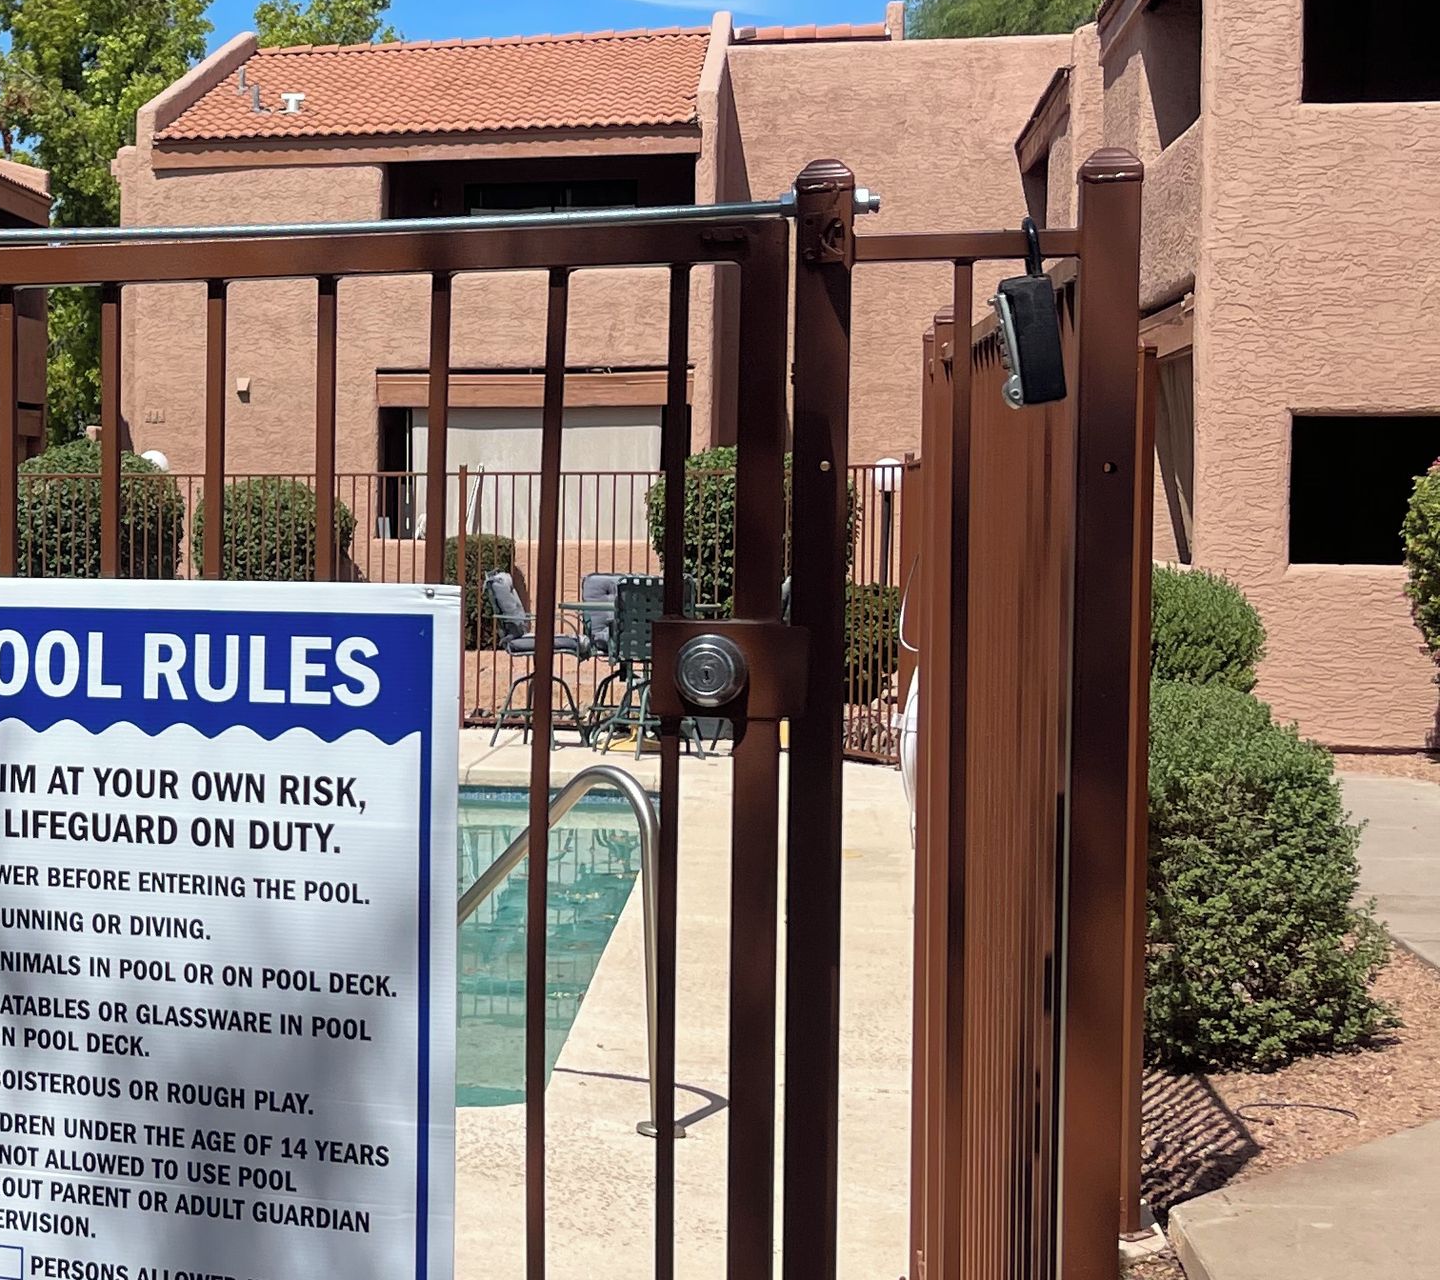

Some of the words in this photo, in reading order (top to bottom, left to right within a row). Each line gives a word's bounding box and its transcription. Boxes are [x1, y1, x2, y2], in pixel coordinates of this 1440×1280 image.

[144, 633, 380, 706] RULES
[47, 766, 84, 795] AT
[93, 768, 178, 799] YOUR
[192, 771, 265, 803] OWN
[280, 775, 365, 814] RISK,
[5, 809, 177, 844] LIFEGUARD
[191, 817, 234, 848] ON
[250, 820, 340, 853] DUTY.
[48, 867, 130, 891] BEFORE
[139, 872, 245, 897] ENTERING
[253, 878, 295, 900] THE
[305, 881, 369, 904] POOL.
[92, 913, 121, 935] OR
[131, 916, 210, 940] DIVING.
[90, 957, 110, 978] IN
[120, 959, 176, 982] POOL
[184, 963, 213, 985] OR
[222, 966, 252, 987] ON
[263, 968, 321, 992] POOL
[330, 973, 396, 997] DECK.
[99, 1001, 128, 1023] OR
[136, 1004, 272, 1033] GLASSWARE
[281, 1014, 302, 1036] IN
[312, 1016, 371, 1041] POOL
[24, 1028, 78, 1051] POOL
[87, 1033, 149, 1057] DECK.
[129, 1080, 158, 1102] OR
[168, 1083, 244, 1109] ROUGH
[255, 1090, 313, 1115] PLAY.
[65, 1118, 137, 1144] UNDER
[144, 1125, 185, 1148] THE
[191, 1129, 236, 1153] AGE
[244, 1134, 272, 1155] OF
[281, 1137, 308, 1159] 14
[315, 1140, 389, 1166] YEARS
[0, 1144, 39, 1166] NOT
[45, 1149, 144, 1177] ALLOWED
[152, 1158, 178, 1180] TO
[188, 1162, 230, 1186] USE
[239, 1166, 296, 1192] POOL
[51, 1182, 131, 1208] PARENT
[139, 1190, 168, 1213] OR
[175, 1194, 245, 1220] ADULT
[252, 1201, 369, 1232] GUARDIAN
